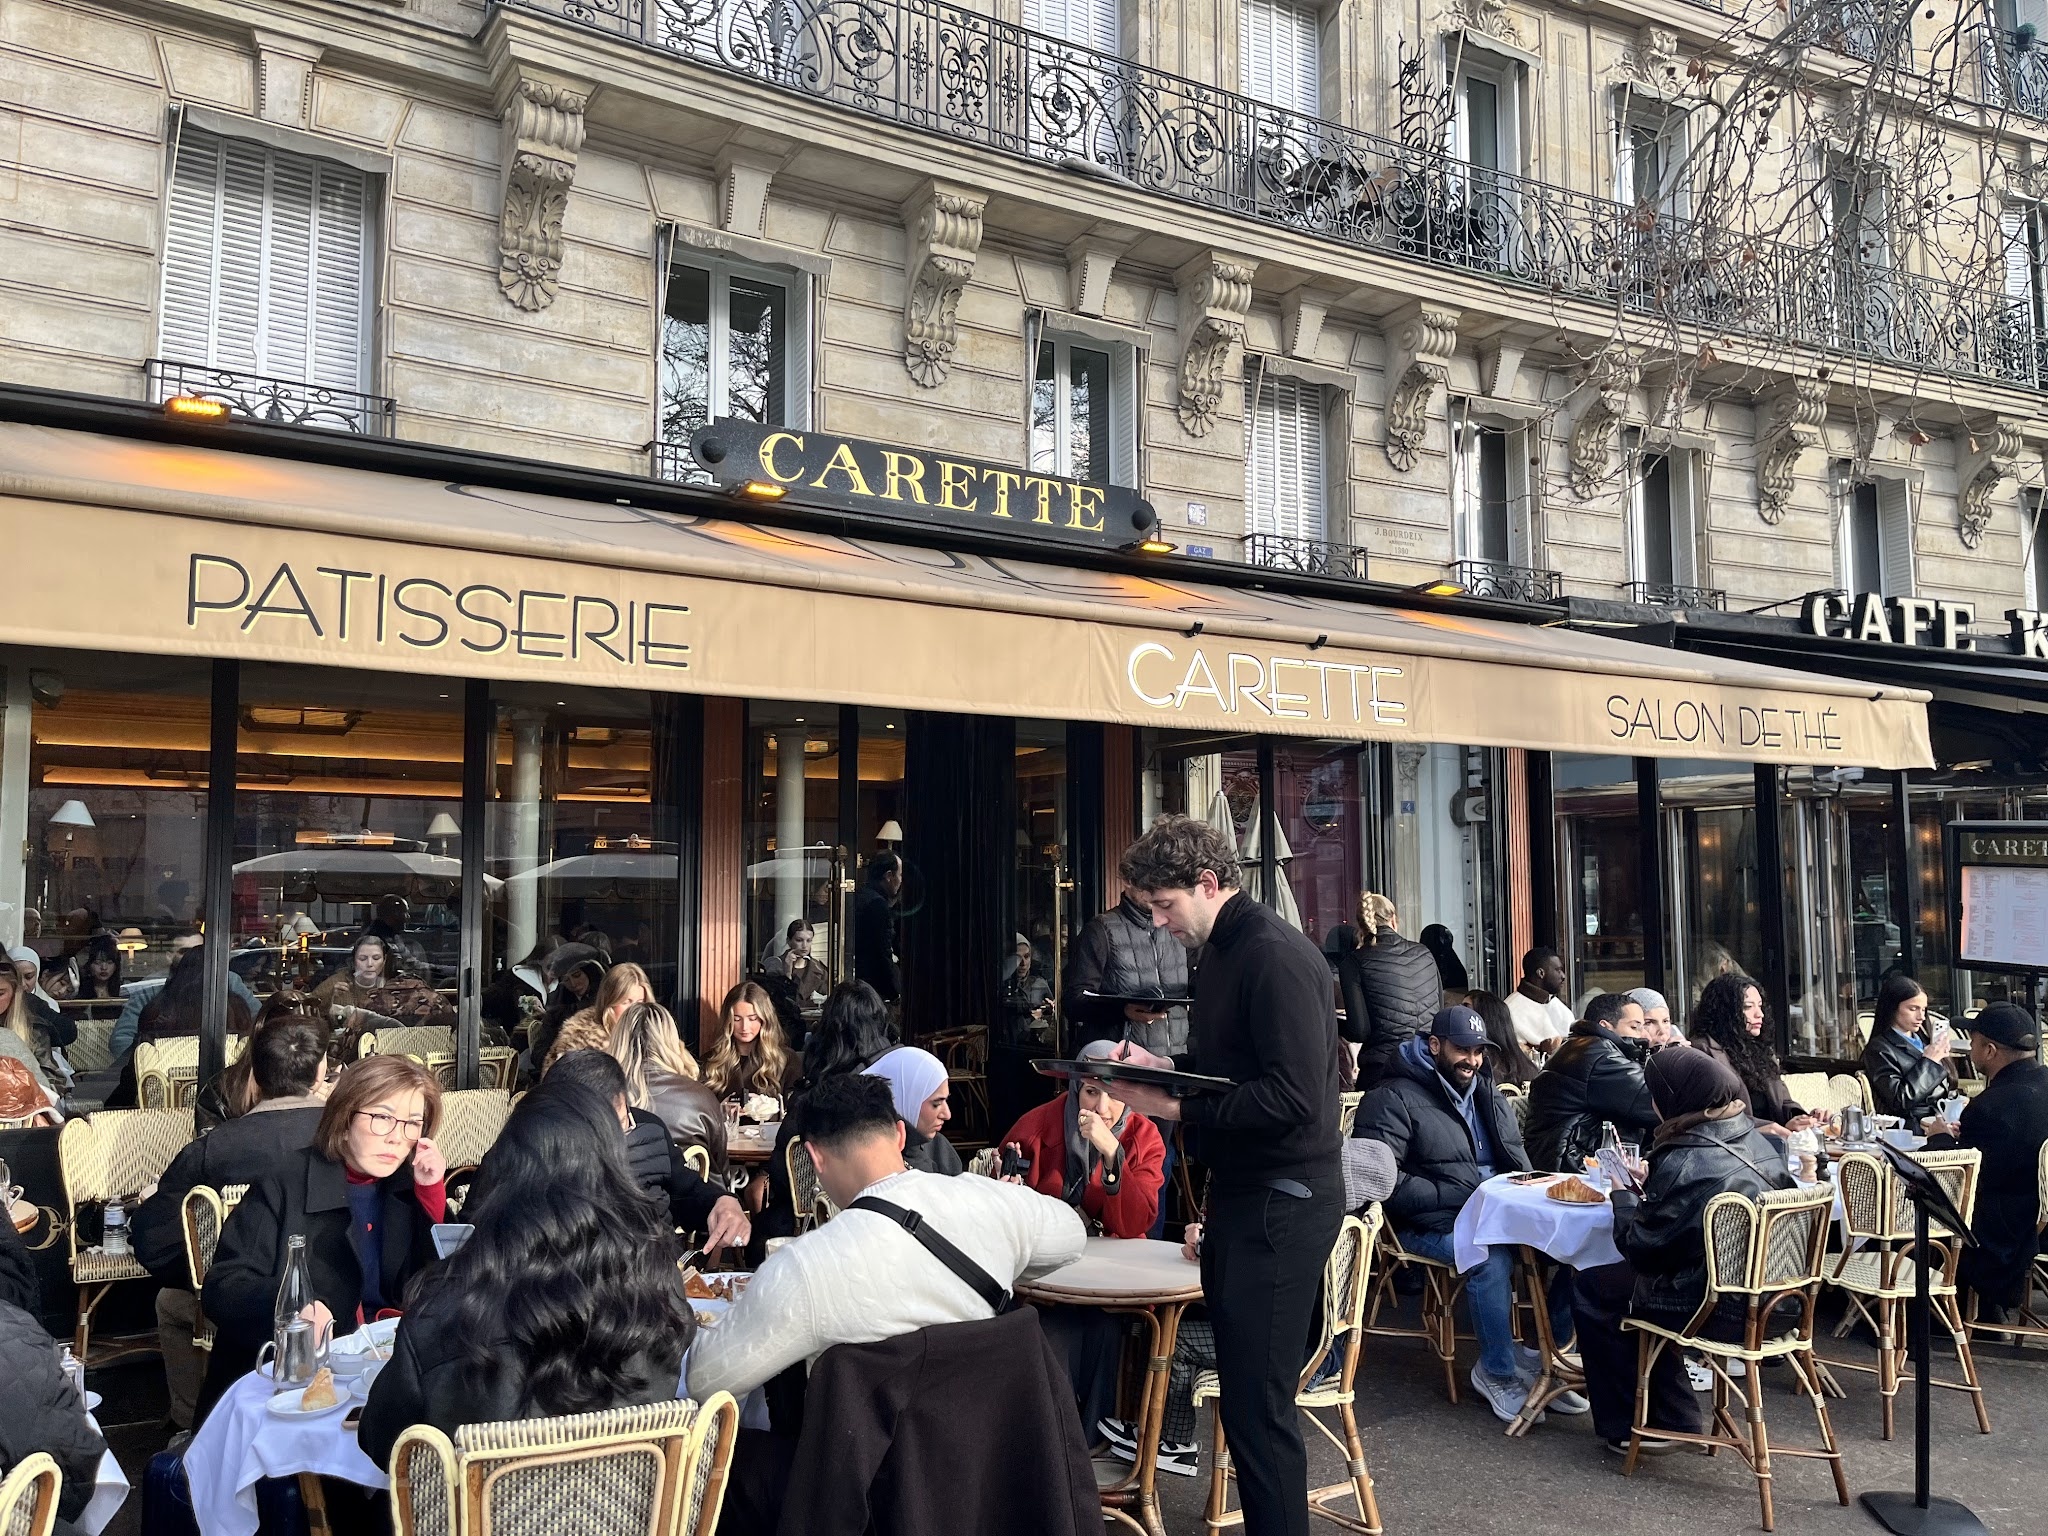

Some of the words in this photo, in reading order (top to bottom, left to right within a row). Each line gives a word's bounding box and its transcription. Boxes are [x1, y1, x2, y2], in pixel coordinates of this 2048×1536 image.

[759, 432, 1105, 532] CARETTE
[1193, 546, 1206, 555] GAZ
[187, 553, 692, 669] PATISSERIE
[1808, 591, 1977, 652] CAFE
[1126, 642, 1408, 727] CARETTE
[1606, 694, 1726, 745] SALON
[1738, 706, 1783, 749] DE
[1784, 706, 1843, 751] THÉ
[1468, 1015, 1484, 1032] NY
